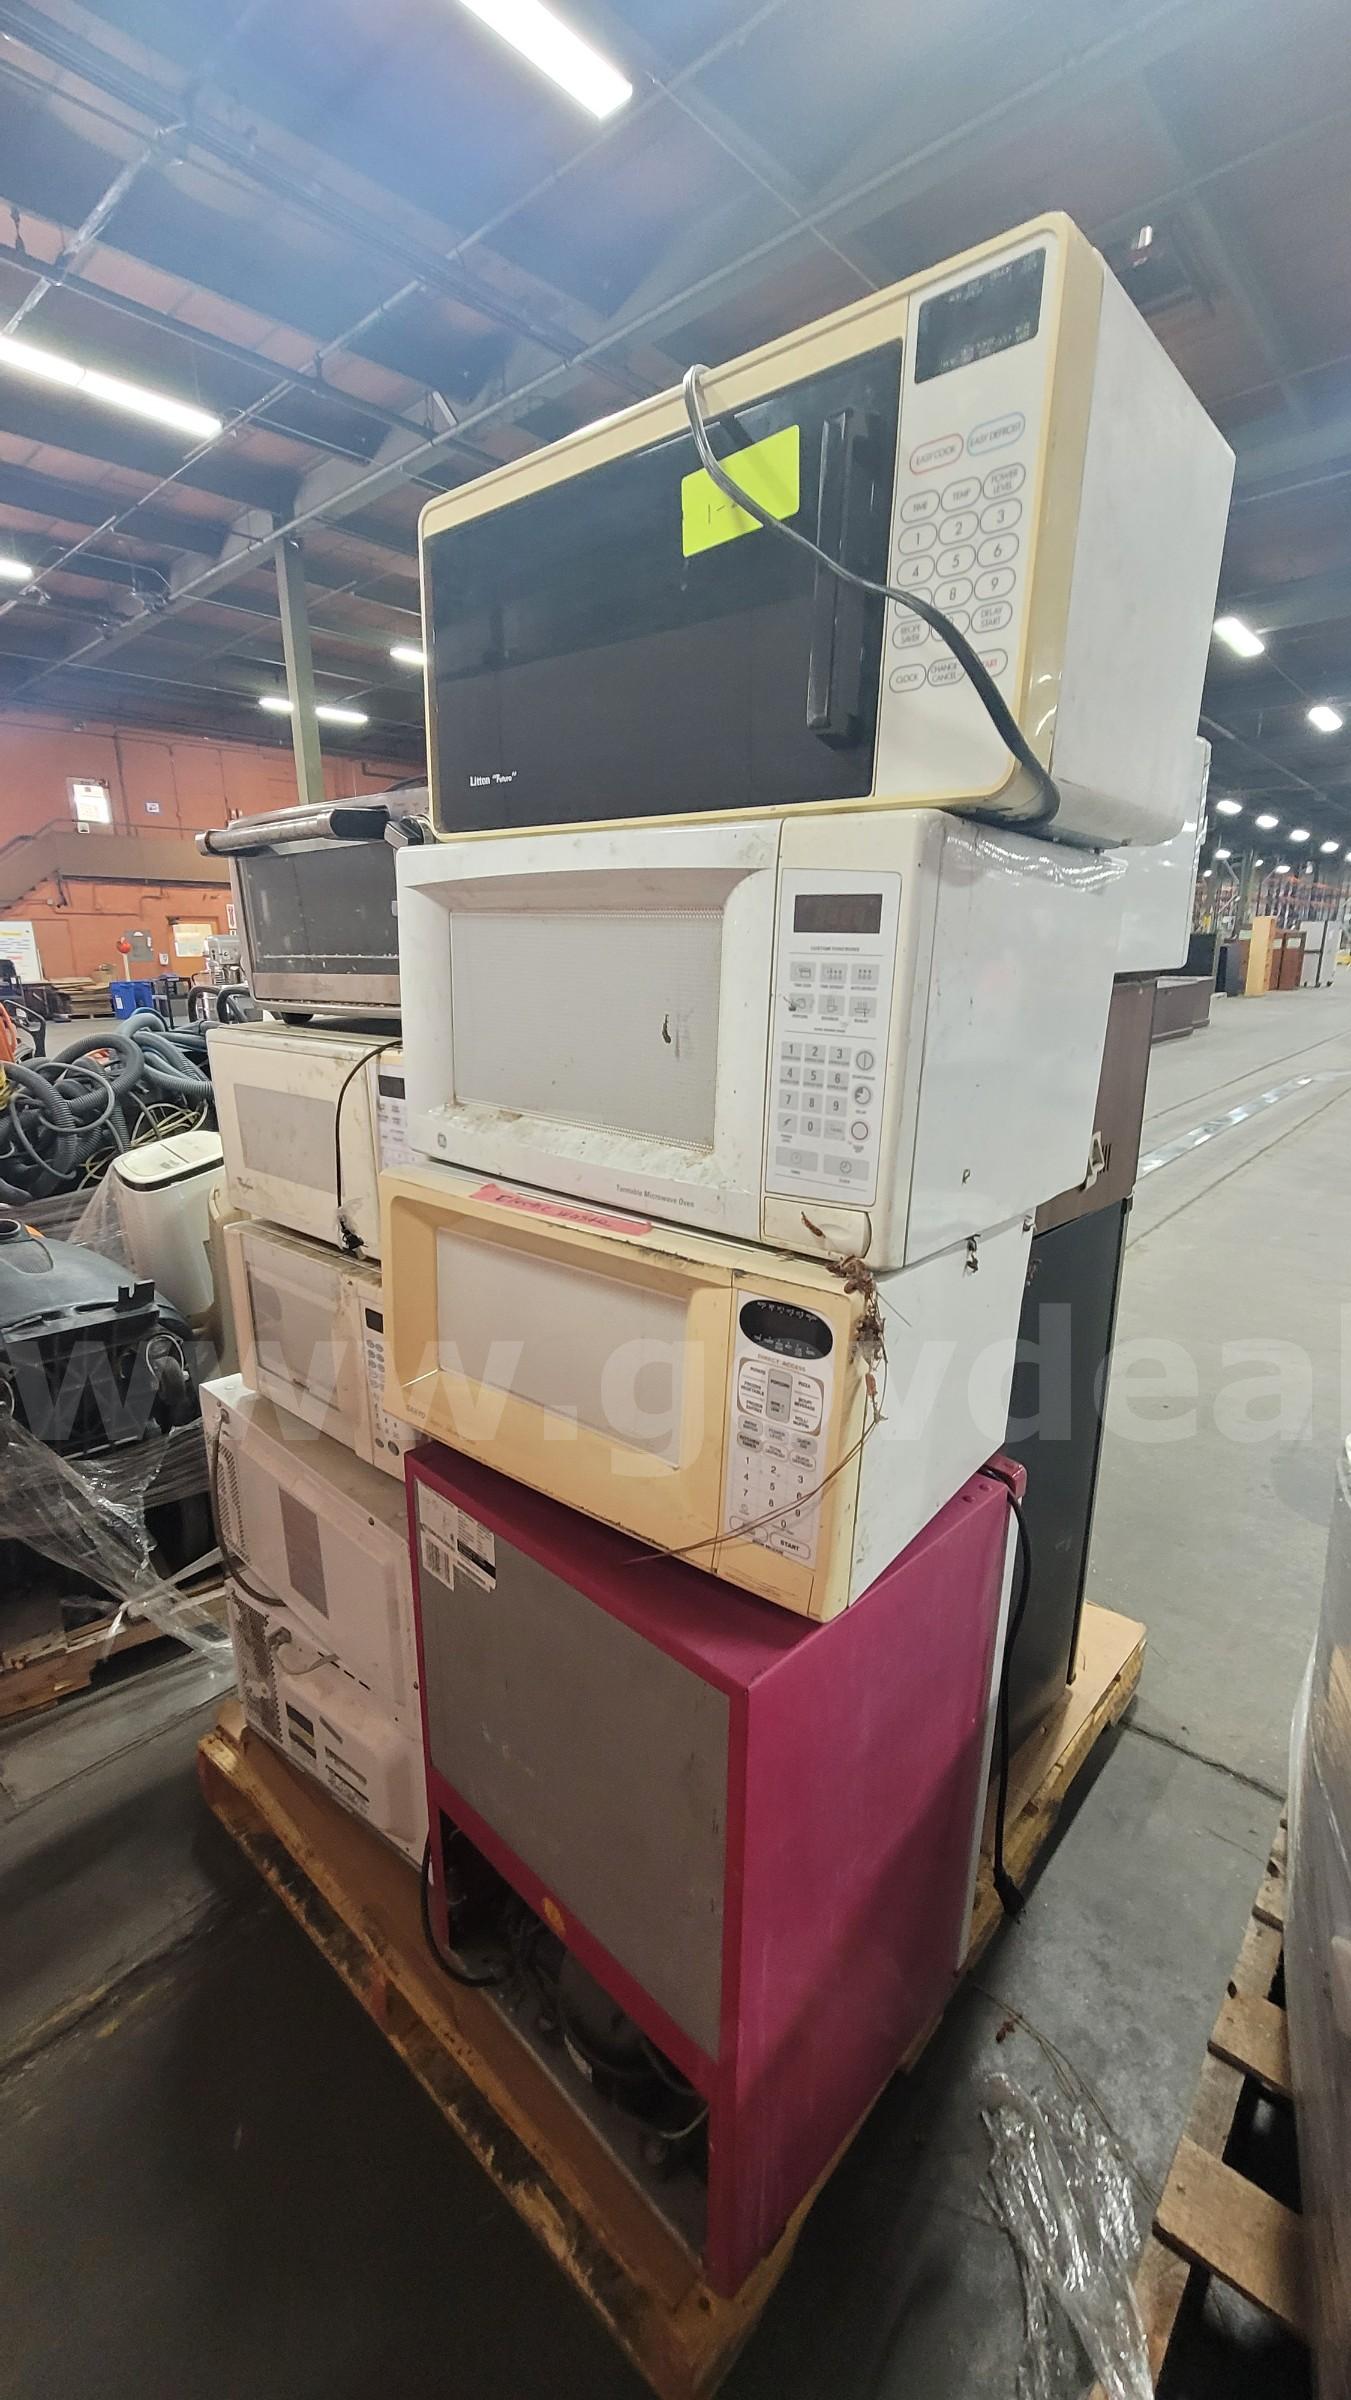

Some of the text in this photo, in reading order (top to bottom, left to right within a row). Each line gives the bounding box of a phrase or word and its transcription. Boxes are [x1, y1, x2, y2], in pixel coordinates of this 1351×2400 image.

[970, 421, 1021, 448] EASY DEFROST
[916, 445, 956, 466] EASY COOK
[953, 487, 971, 501] TEMP
[913, 501, 928, 512] TIME
[996, 508, 1005, 524] 3
[954, 521, 963, 536] 2
[993, 543, 1002, 558] 6
[951, 553, 960, 569] 5
[912, 565, 920, 578] 4
[991, 576, 999, 591] 9
[949, 587, 957, 601] 8
[980, 607, 1002, 618] DELAY
[980, 615, 1001, 628] START
[895, 674, 918, 684] CLOCK
[789, 1043, 794, 1055] 1
[812, 1045, 818, 1057] 2
[836, 1047, 843, 1060] 3
[787, 1067, 793, 1078] 4
[810, 1069, 817, 1081] 5
[834, 1072, 841, 1084] 6
[785, 1094, 792, 1105] 7
[808, 1097, 815, 1108] 8
[832, 1100, 839, 1112] 9
[807, 1120, 814, 1132] 0
[643, 1189, 677, 1204] Microwave
[678, 1197, 695, 1208] Oven
[782, 1361, 806, 1372] ACCESS
[780, 1540, 800, 1552] START
